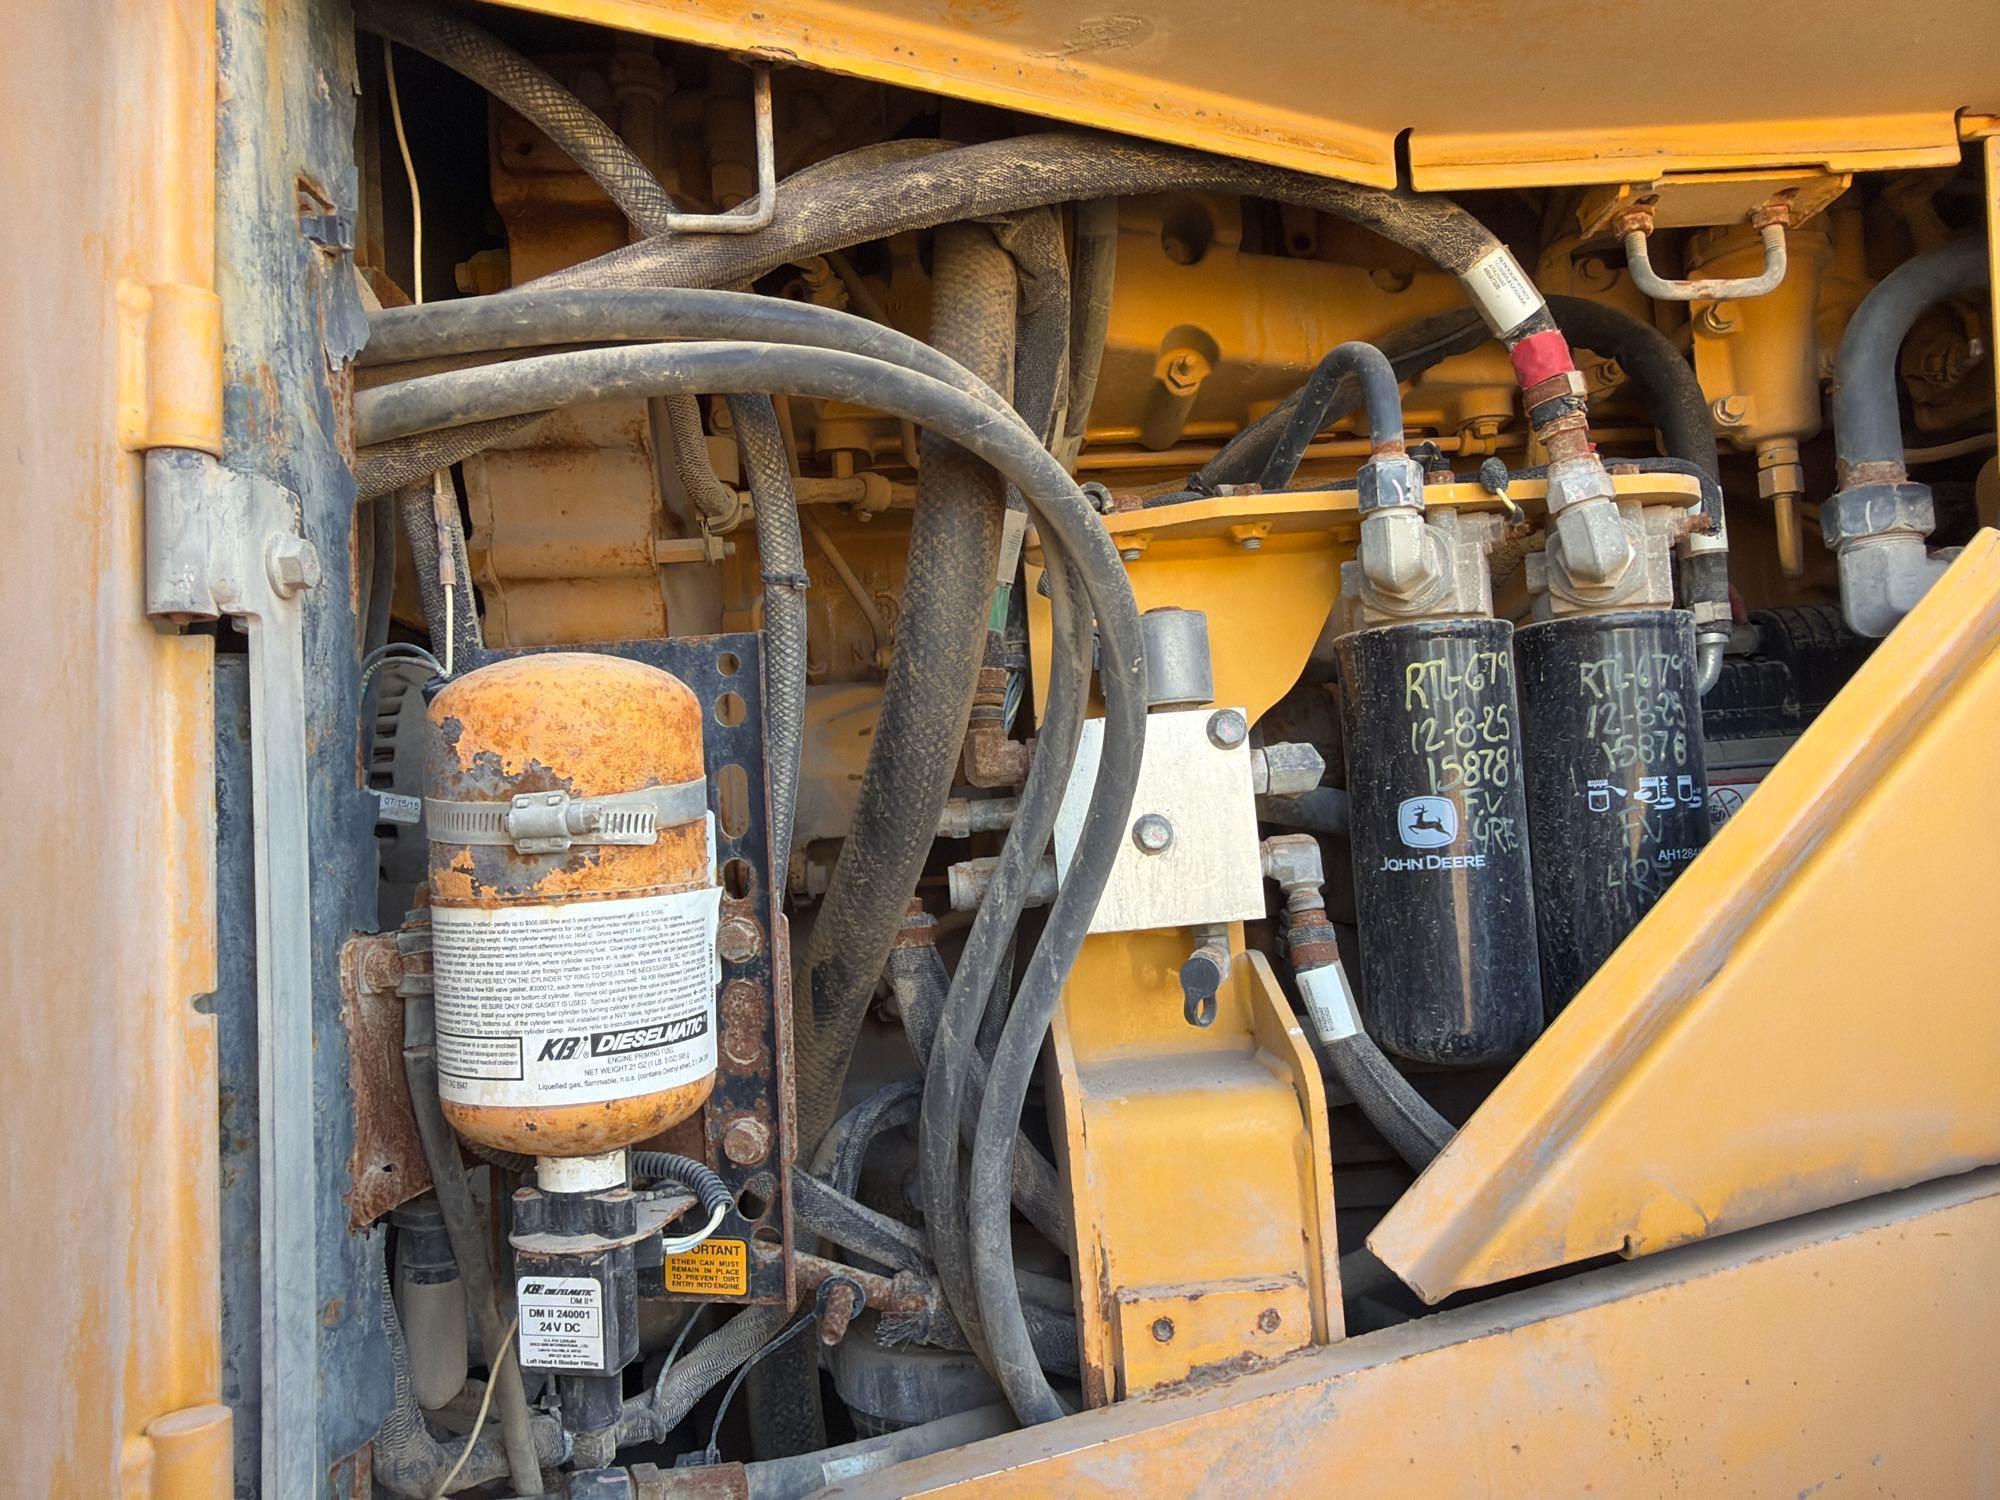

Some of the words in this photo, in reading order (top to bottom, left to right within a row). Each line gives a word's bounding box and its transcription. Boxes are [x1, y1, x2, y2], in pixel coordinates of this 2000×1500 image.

[1412, 704, 1510, 754] 12-8-25
[1380, 855, 1424, 871] JOHN
[1427, 854, 1486, 869] DEERE
[596, 1015, 702, 1052] DIESELMATIC
[607, 1054, 632, 1064] ENGINE
[634, 1050, 660, 1060] PRIMING
[584, 1068, 598, 1076] NET
[600, 1063, 627, 1075] WEIGHT
[629, 1062, 637, 1070] 21
[638, 1061, 647, 1069] OZ
[538, 1082, 567, 1091] Liquefied
[569, 1081, 582, 1090] gas,
[584, 1076, 619, 1087] flammable,
[686, 1245, 741, 1256] ORTANT
[529, 1309, 544, 1318] DM
[548, 1310, 554, 1318] II
[556, 1310, 590, 1319] 240001
[565, 1323, 580, 1332] DC
